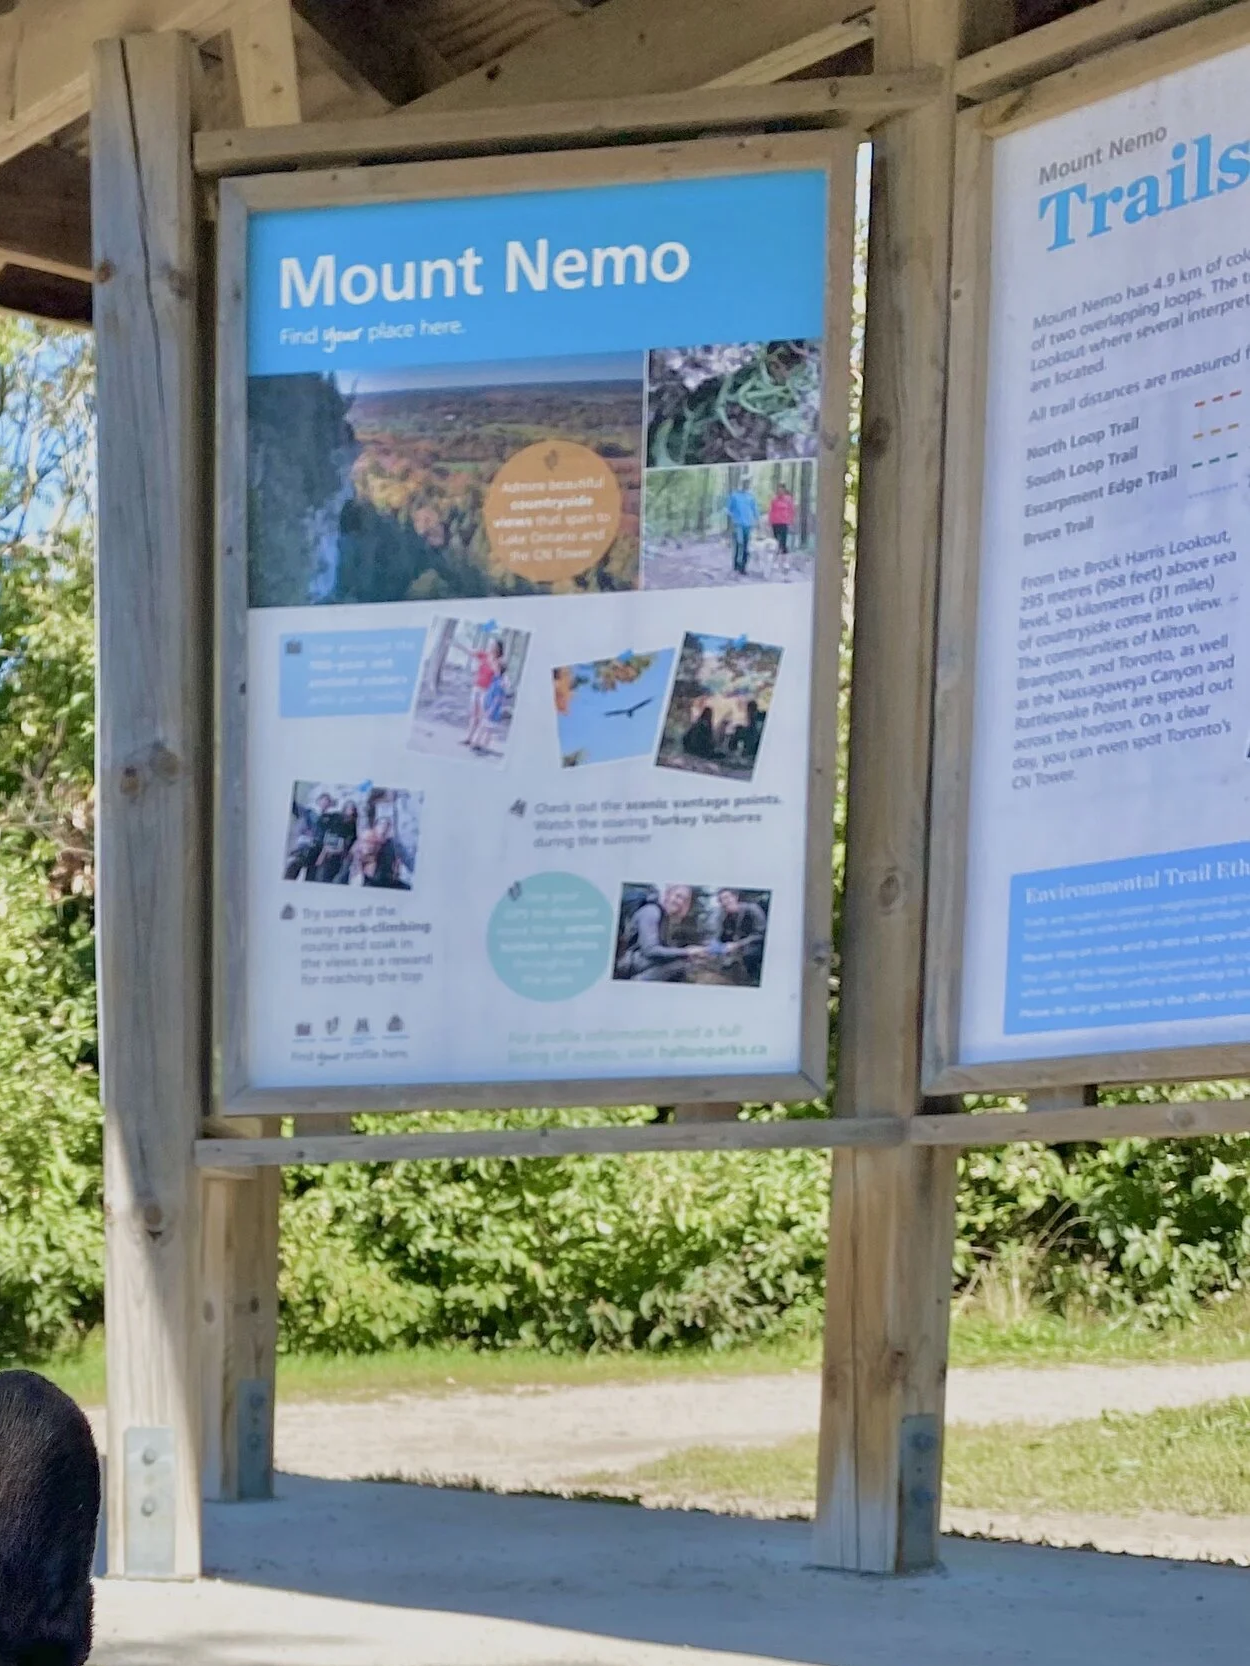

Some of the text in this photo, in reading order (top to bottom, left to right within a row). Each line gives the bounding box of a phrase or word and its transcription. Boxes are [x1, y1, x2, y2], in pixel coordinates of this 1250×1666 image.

[1039, 126, 1167, 184] Mount Nemo
[1038, 134, 1250, 251] Trails
[279, 238, 691, 309] Mount Nemo
[1033, 307, 1077, 330] Mount
[1082, 292, 1123, 314] Nemo
[1127, 283, 1149, 299] has
[1153, 272, 1175, 289] 4.9
[1179, 266, 1202, 282] km
[1206, 255, 1222, 274] of
[279, 318, 466, 353] Find your place here.
[1031, 277, 1238, 351] of two overlapping loops. The
[1030, 344, 1085, 372] Lookout
[1089, 332, 1132, 353] where
[1136, 311, 1184, 339] several
[1029, 405, 1047, 422] All
[1050, 397, 1075, 418] trail
[1078, 381, 1140, 409] distances
[1144, 374, 1166, 390] are
[1171, 347, 1241, 381] measured
[1030, 356, 1107, 393] are located.
[1027, 416, 1139, 461] North Loop Trail
[1026, 445, 1138, 489] South Loop Trail
[1024, 464, 1177, 517] Escarpment Edge Trail
[1024, 515, 1094, 546] Bruce Trail
[1021, 530, 1231, 591] From the Brock Harris Lookout,
[1047, 584, 1093, 604] metres
[1130, 565, 1162, 584] feet)
[1166, 557, 1209, 576] above
[1214, 551, 1237, 567] sea
[1075, 592, 1145, 617] kilometres
[1149, 585, 1169, 604] (31
[1175, 573, 1215, 596] miles)
[1017, 635, 1032, 651] of
[1036, 620, 1111, 647] countryside
[1115, 612, 1152, 629] come
[1157, 605, 1184, 620] into
[1018, 656, 1041, 670] The
[1045, 638, 1129, 665] communities
[1132, 630, 1147, 647] of
[1089, 657, 1114, 676] and
[1180, 645, 1195, 657] as
[1199, 633, 1228, 653] well
[1016, 698, 1029, 711] as
[1033, 693, 1054, 707] the
[1151, 664, 1203, 684] Canyon
[1207, 653, 1234, 672] and
[1093, 699, 1126, 716] Point
[1131, 695, 1153, 708] are
[1157, 681, 1204, 706] spread
[1208, 678, 1233, 694] out
[1013, 734, 1052, 751] across
[1056, 728, 1077, 742] the
[1140, 713, 1161, 727] On
[1164, 711, 1173, 722] a
[1177, 705, 1210, 720] clear
[1042, 751, 1066, 768] you
[1070, 746, 1093, 759] can
[1097, 740, 1129, 755] even
[1132, 733, 1161, 751] spot
[673, 796, 730, 811] vantage
[1012, 775, 1031, 790] CN
[652, 814, 698, 828] Turkey
[1026, 869, 1160, 904] Environmental
[1164, 862, 1211, 886] Trail
